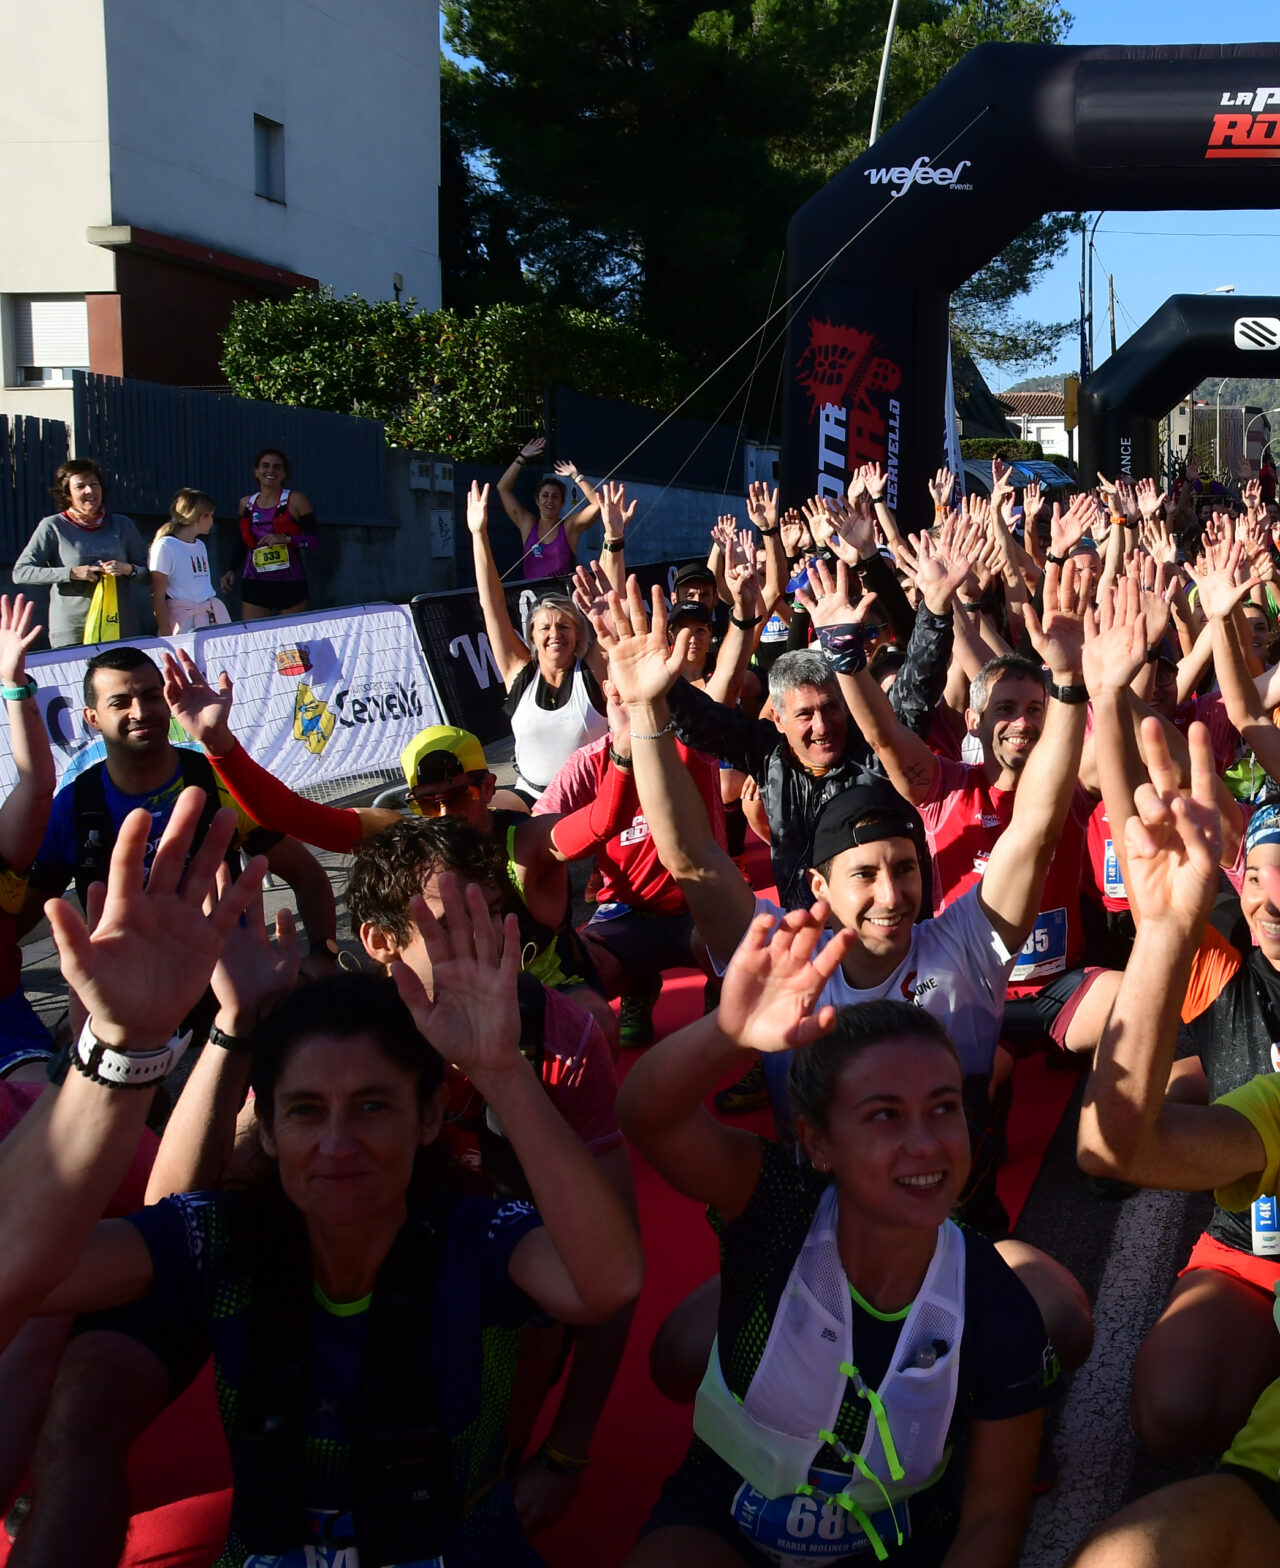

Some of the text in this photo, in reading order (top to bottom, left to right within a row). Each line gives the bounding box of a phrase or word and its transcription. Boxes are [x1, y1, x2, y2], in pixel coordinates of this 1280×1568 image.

[1220, 92, 1253, 106] LA
[864, 156, 972, 197] wefeel
[949, 182, 974, 191] events
[886, 399, 900, 510] CERVELLO
[1259, 1202, 1272, 1226] 14K
